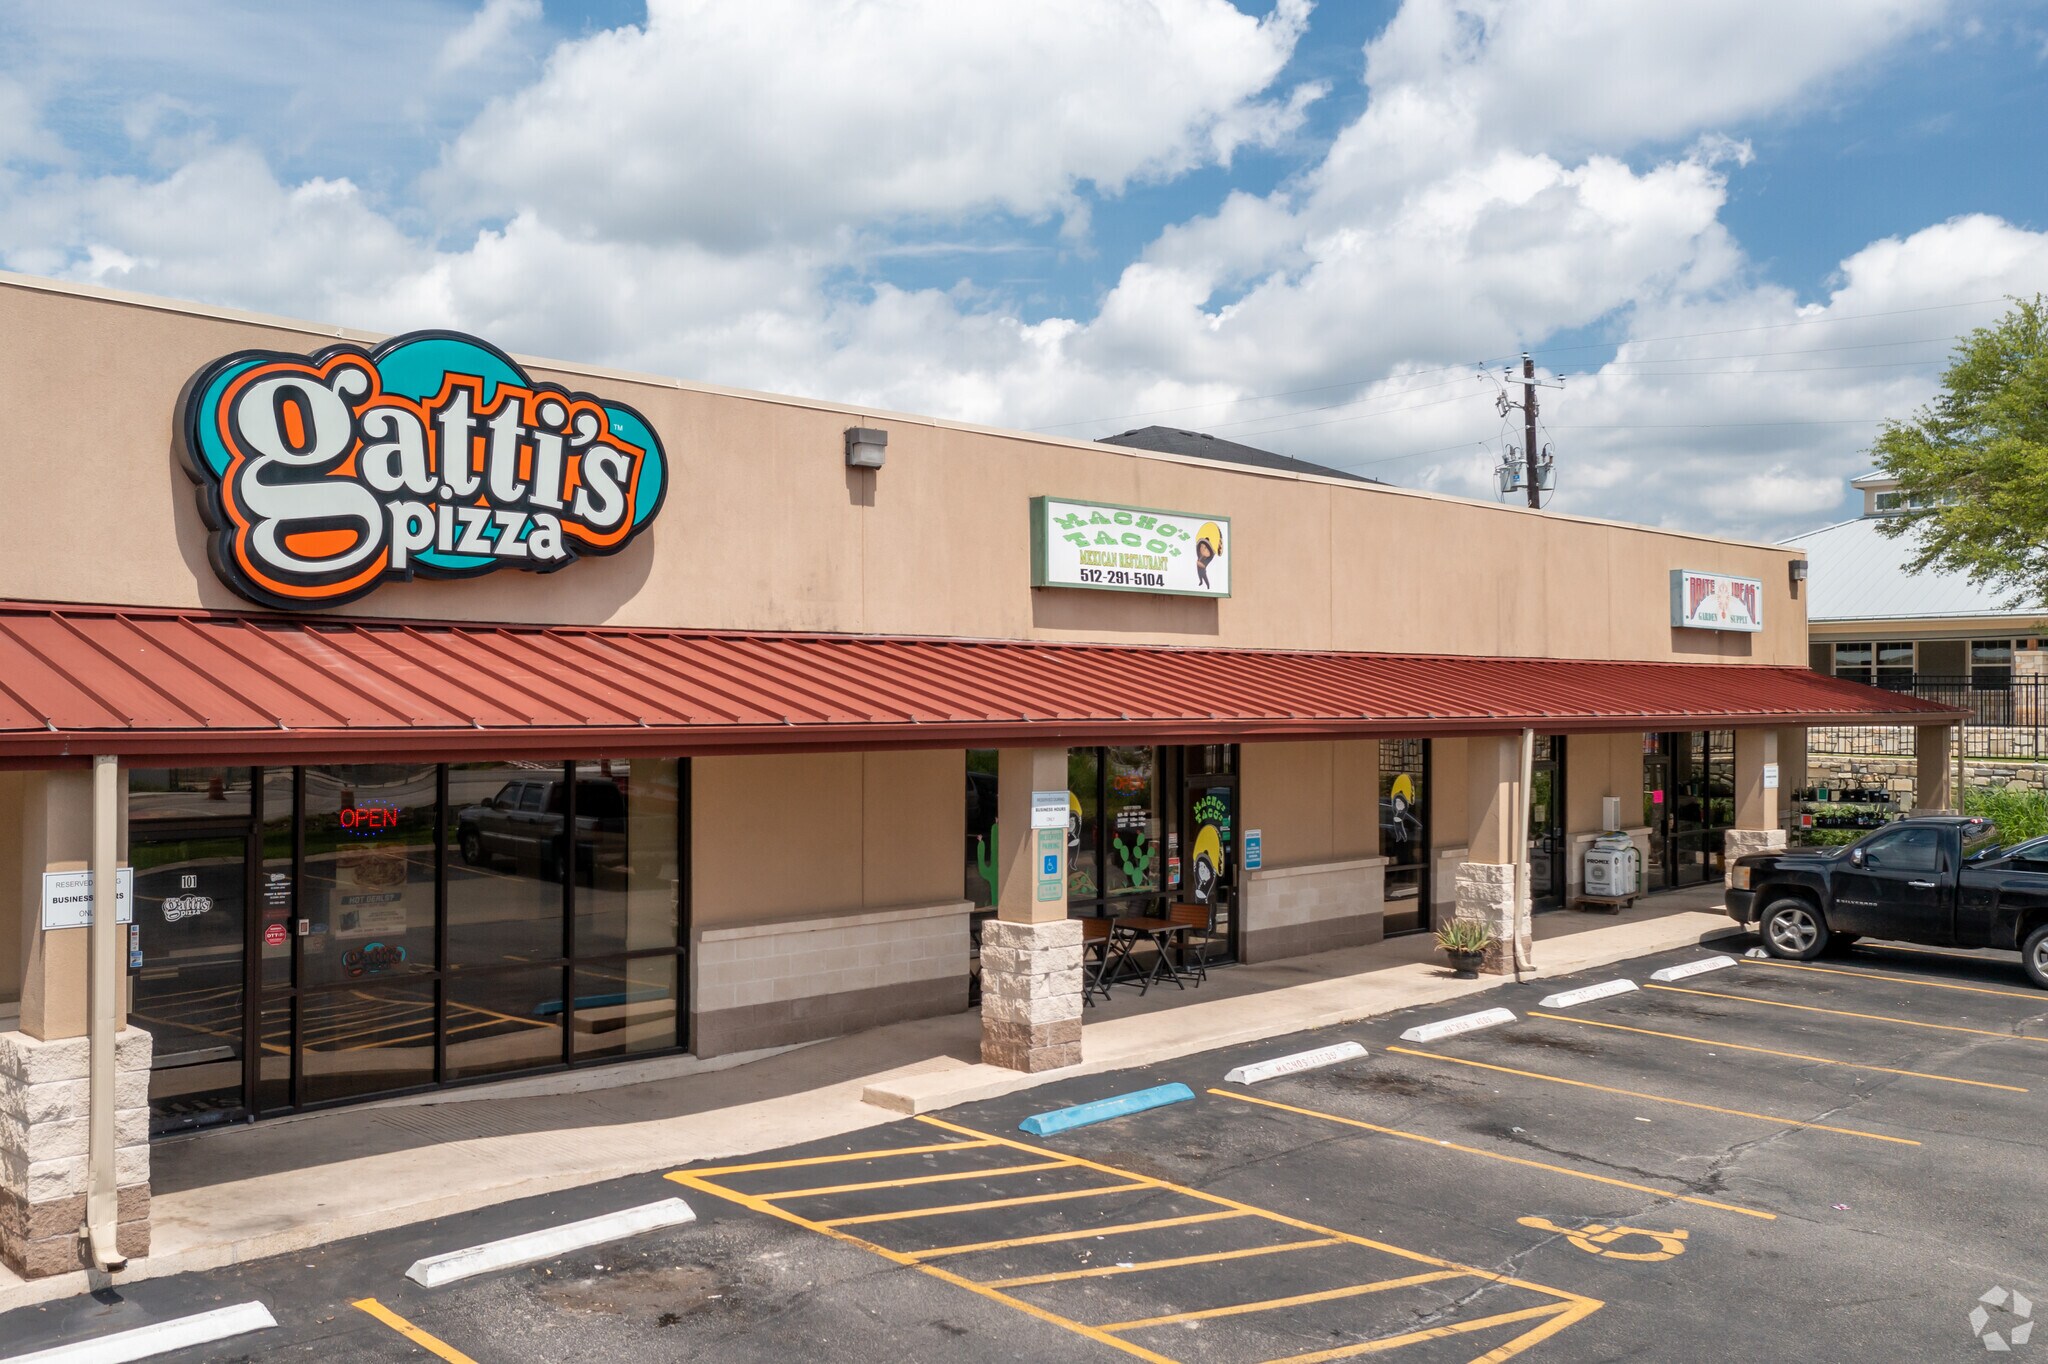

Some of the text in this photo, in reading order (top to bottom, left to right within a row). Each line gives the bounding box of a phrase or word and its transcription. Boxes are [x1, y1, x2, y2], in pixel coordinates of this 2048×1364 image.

[237, 368, 631, 573] gatti's
[385, 485, 567, 569] pizza
[1079, 549, 1169, 572] MEXICAN RESTAURANT
[1080, 568, 1165, 587] 512-291-5104
[1690, 577, 1756, 625] BRITE IDEAS
[1698, 612, 1749, 625] GARDEN SUPPLY
[340, 808, 399, 828] OPEN
[55, 879, 94, 889] RESERVED
[182, 875, 197, 888] 101
[52, 894, 94, 904] BUSINESS
[78, 909, 94, 917] ONL
[165, 898, 209, 920] gatti's
[181, 909, 201, 917] pizza
